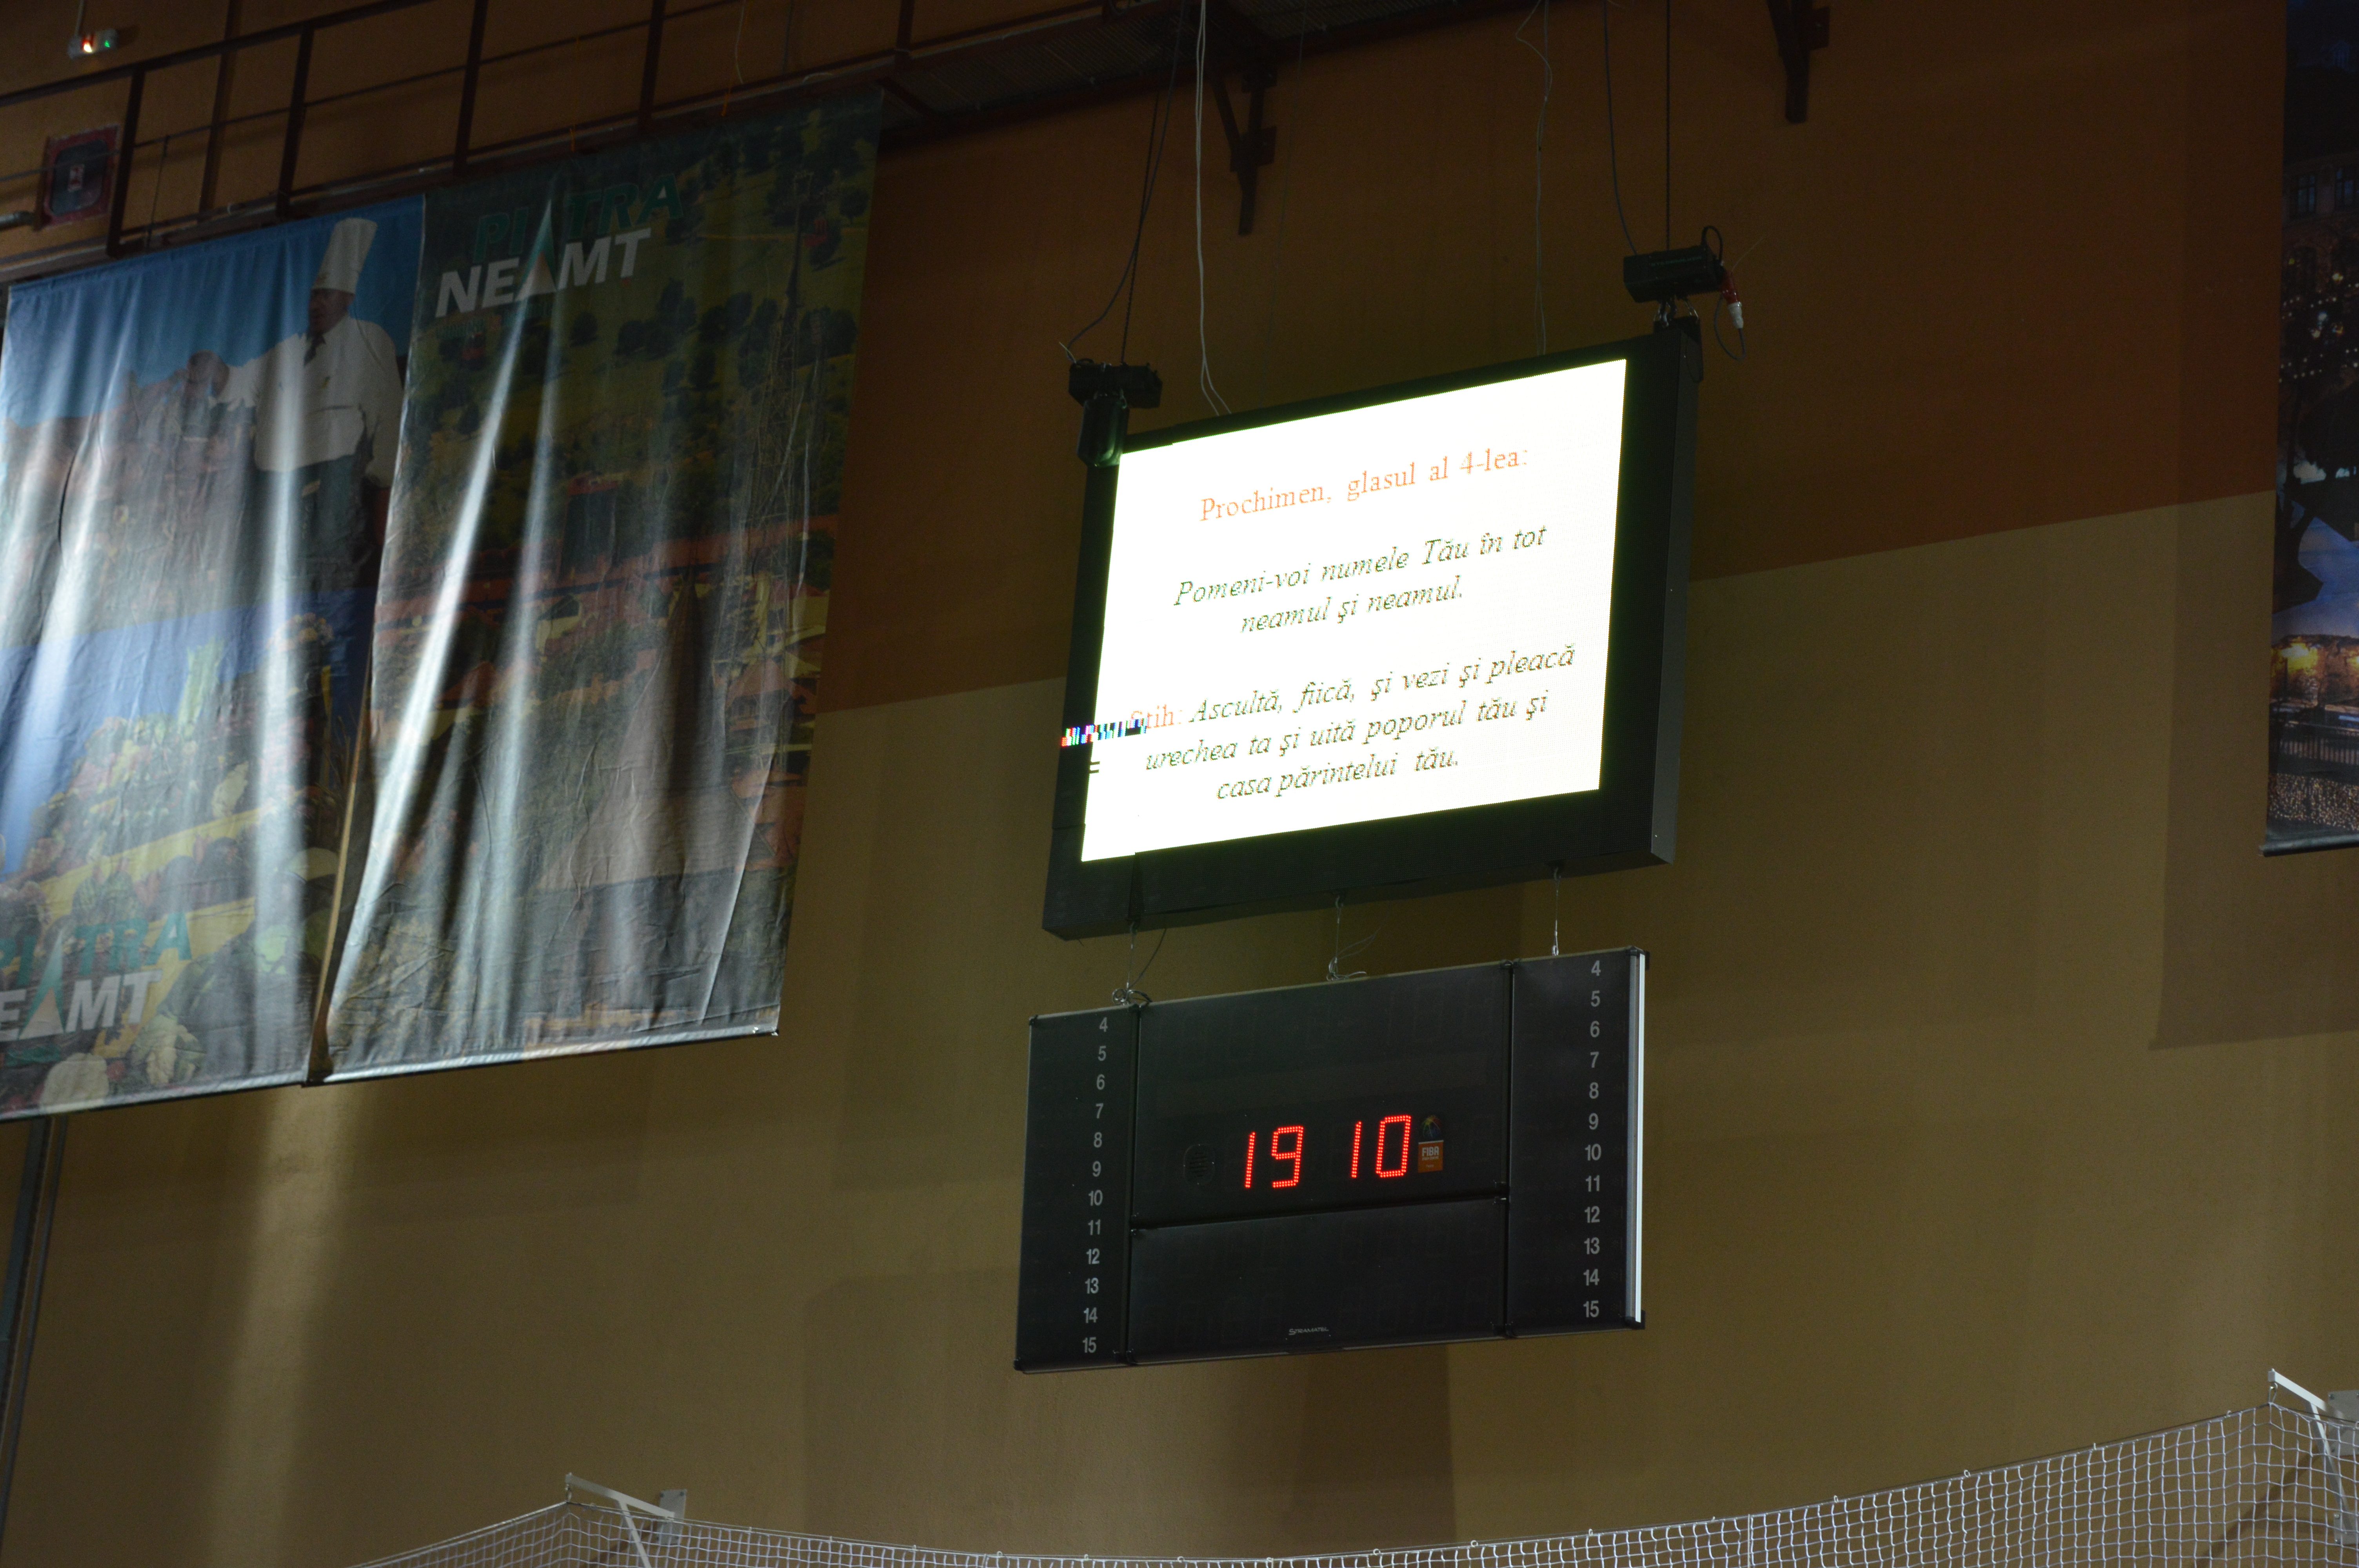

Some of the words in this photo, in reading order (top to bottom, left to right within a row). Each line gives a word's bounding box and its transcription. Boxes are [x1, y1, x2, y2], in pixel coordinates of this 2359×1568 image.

[1199, 486, 1332, 521] Prochimen,
[1347, 462, 1416, 502] glasul
[1428, 456, 1448, 481] al
[1459, 448, 1528, 475] 4-lea:
[1173, 562, 1312, 606] Pomeni-voi
[1320, 545, 1410, 582] numele
[1421, 538, 1470, 565] Tău
[1479, 532, 1503, 555] în
[1512, 525, 1547, 550] tot
[1239, 596, 1333, 633] neamul
[1366, 574, 1463, 613] neamul.
[1188, 688, 1282, 723] Ascultă,
[1292, 677, 1354, 713] fiică,
[1401, 662, 1451, 690] vezi
[1484, 642, 1576, 685] pleacă
[1145, 739, 1238, 771] urechea
[1248, 735, 1272, 756] ta
[1310, 718, 1357, 746] uită
[1361, 699, 1468, 746] poporul
[1476, 697, 1518, 722] tău
[1216, 777, 1272, 800] casa
[1273, 751, 1401, 798] părintelui
[1414, 746, 1458, 772] tău.
[1590, 960, 1601, 976] 4
[1590, 990, 1601, 1007] 5
[1099, 1016, 1109, 1033] 4
[1590, 1020, 1600, 1038] 6
[1098, 1045, 1107, 1062] 5
[1590, 1051, 1599, 1069] 7
[1096, 1073, 1105, 1091] 6
[1588, 1082, 1599, 1100] 8
[1095, 1102, 1104, 1119] 7
[1588, 1112, 1599, 1131] 9
[1093, 1131, 1103, 1149] 8
[1245, 1124, 1304, 1189] 19
[1351, 1114, 1412, 1178] 10
[1421, 1145, 1439, 1156] FIBA
[1584, 1143, 1602, 1161] 10
[1092, 1160, 1102, 1178] 9
[1585, 1174, 1600, 1192] 11
[1088, 1189, 1103, 1207] 10
[1584, 1205, 1600, 1223] 12
[1087, 1219, 1101, 1236] 11
[1583, 1236, 1600, 1255] 13
[1086, 1248, 1100, 1265] 12
[1085, 1277, 1099, 1294] 13
[1583, 1268, 1600, 1286] 14
[1083, 1307, 1098, 1323] 14
[1583, 1299, 1600, 1318] 15
[1082, 1336, 1097, 1354] 15
